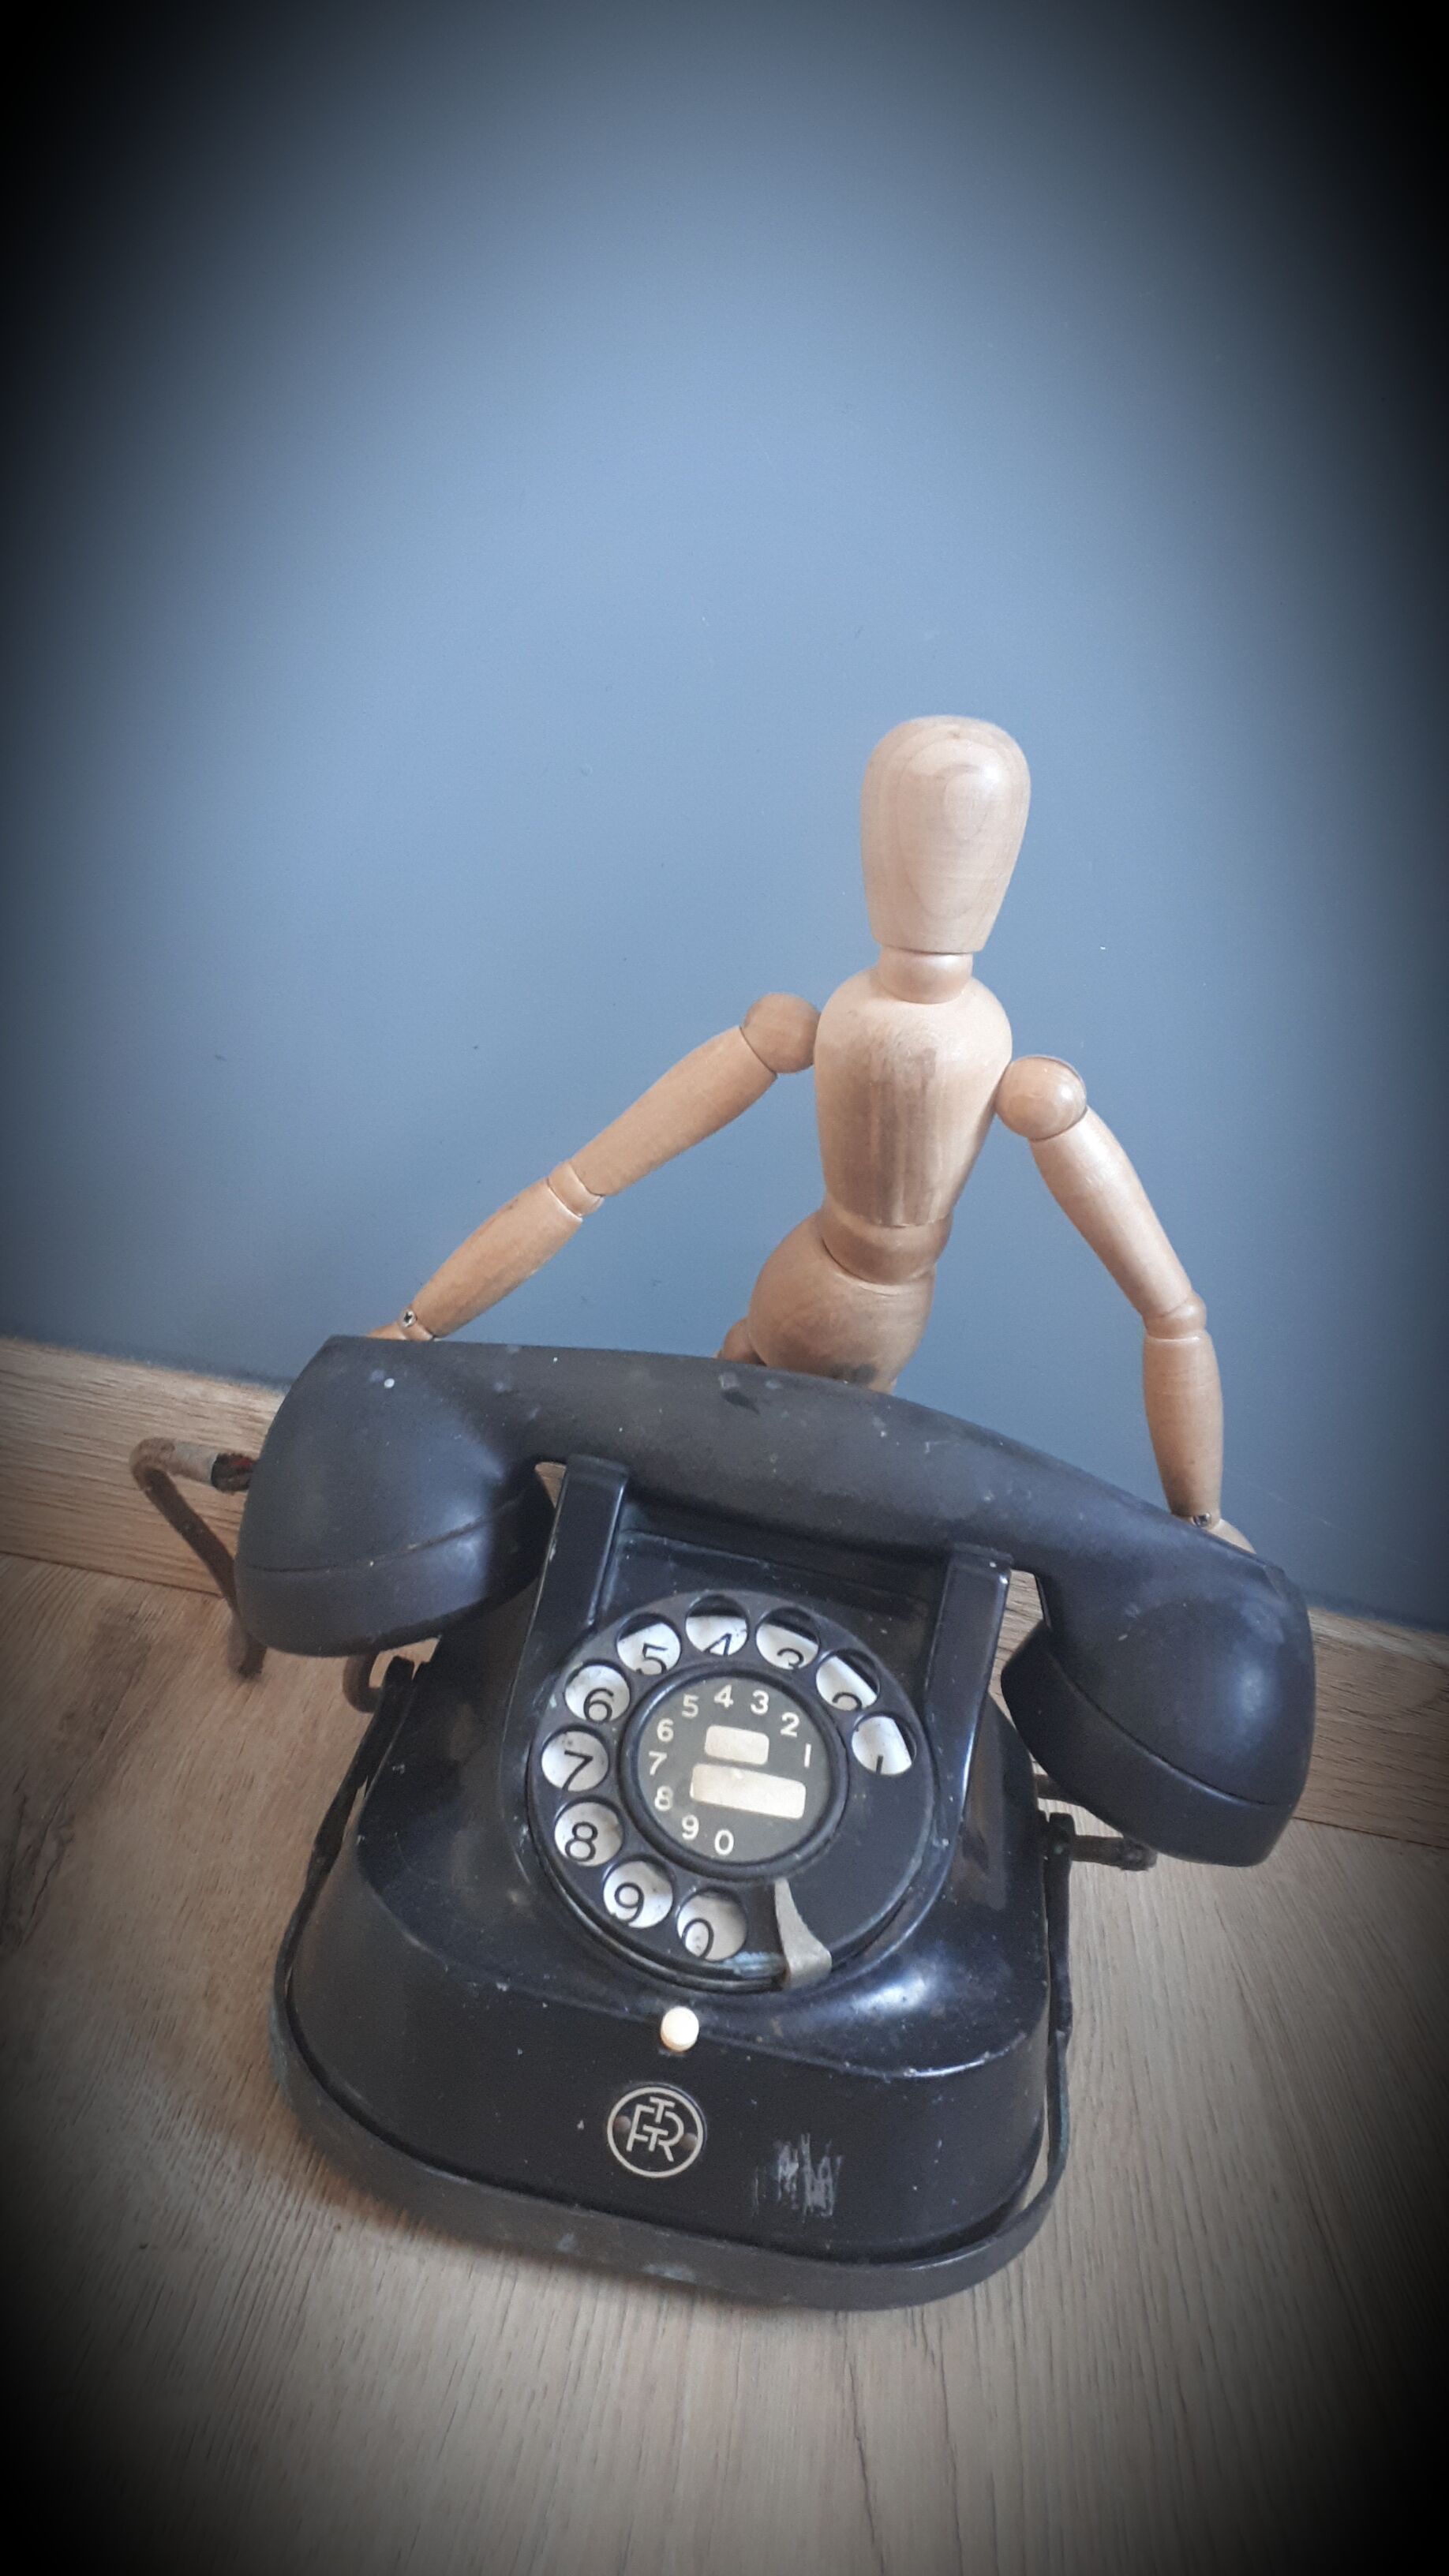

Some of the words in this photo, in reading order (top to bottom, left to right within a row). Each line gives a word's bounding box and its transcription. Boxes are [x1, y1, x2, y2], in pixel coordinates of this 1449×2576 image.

[635, 1642, 668, 1675] 5
[583, 1687, 614, 1724] 6
[681, 1694, 699, 1719] 5
[713, 1683, 734, 1709] 4
[750, 1689, 769, 1715] 3
[657, 1717, 675, 1743] 6
[780, 1711, 800, 1738] 2
[563, 1749, 593, 1791] 7
[648, 1750, 668, 1776] 7
[654, 1785, 673, 1811] 8
[681, 1814, 700, 1840] 9
[564, 1821, 598, 1863] 8
[714, 1829, 735, 1856] 0
[611, 1881, 645, 1926] 9
[682, 1918, 714, 1958] 0
